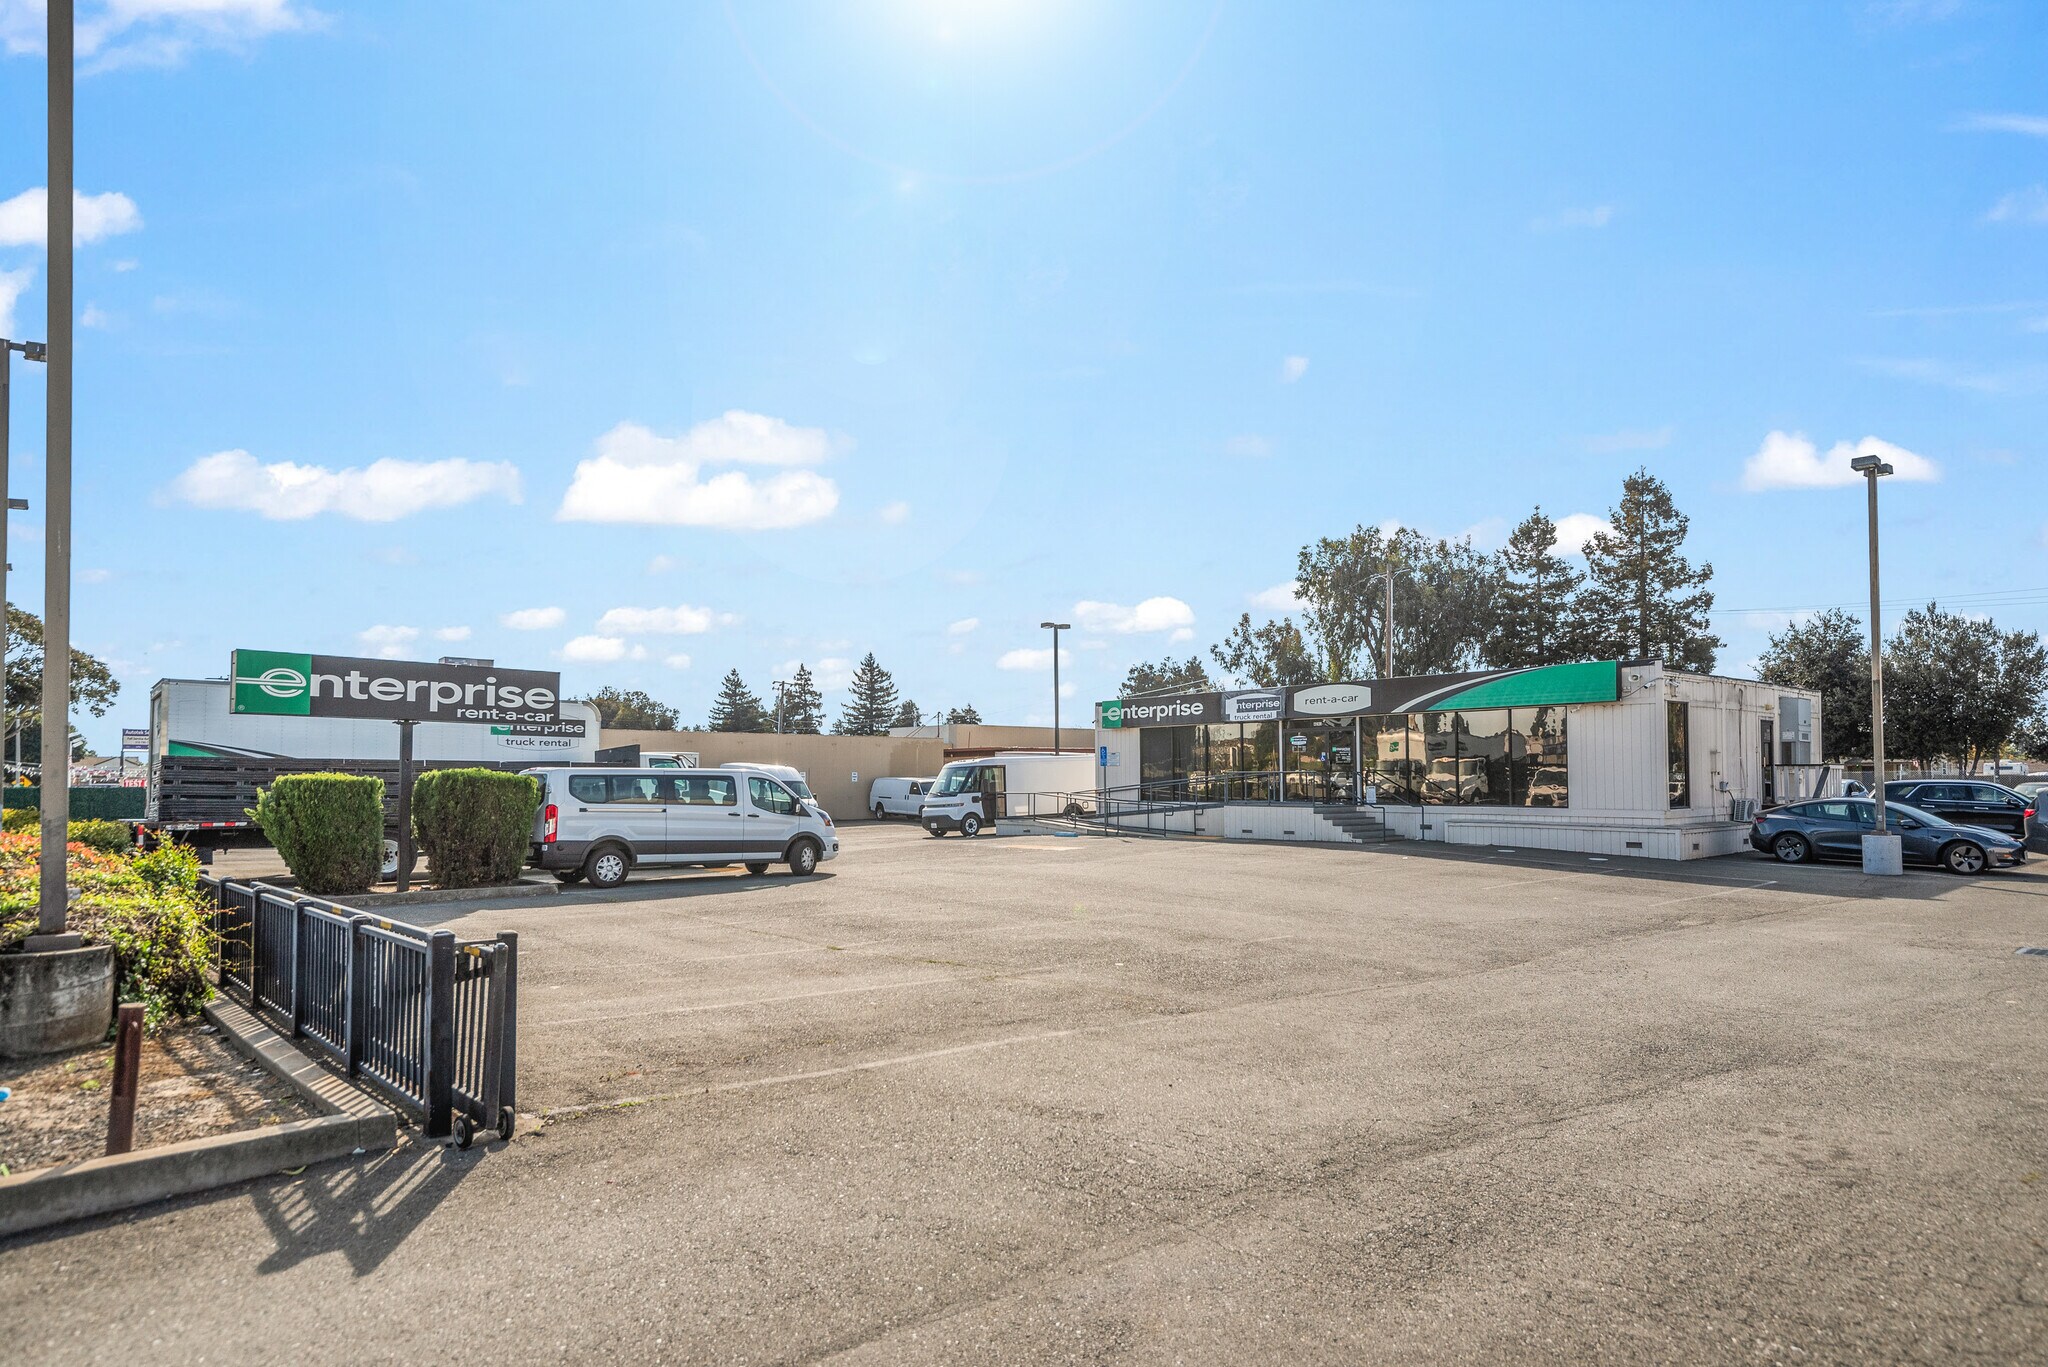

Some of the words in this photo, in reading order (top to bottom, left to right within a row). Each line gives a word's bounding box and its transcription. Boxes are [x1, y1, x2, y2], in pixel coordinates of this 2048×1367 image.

[238, 667, 556, 712] enterprise
[1305, 695, 1359, 705] rent-a-car
[456, 708, 555, 722] rent-a-car
[1102, 700, 1204, 721] enterprise
[506, 738, 535, 746] truck
[540, 739, 571, 747] rental
